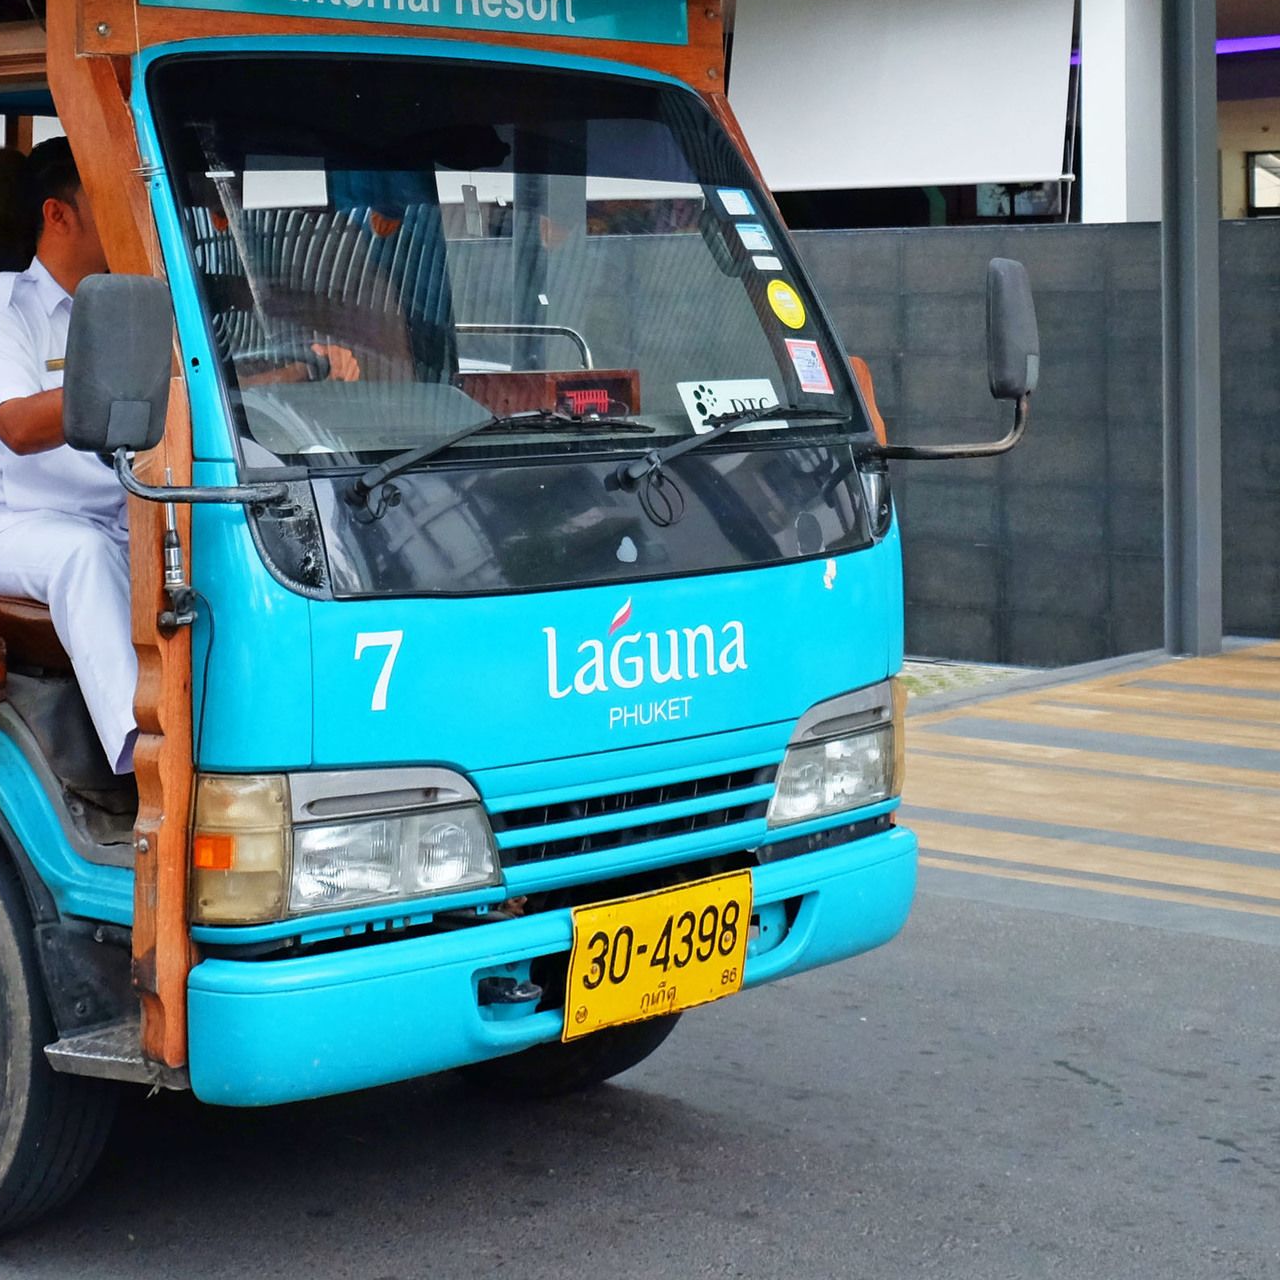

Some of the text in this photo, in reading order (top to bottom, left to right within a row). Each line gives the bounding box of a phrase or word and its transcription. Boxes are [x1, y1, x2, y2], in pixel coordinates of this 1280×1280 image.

[353, 629, 404, 711] 7
[609, 696, 693, 729] PHUKET
[583, 900, 740, 989] 30-4398
